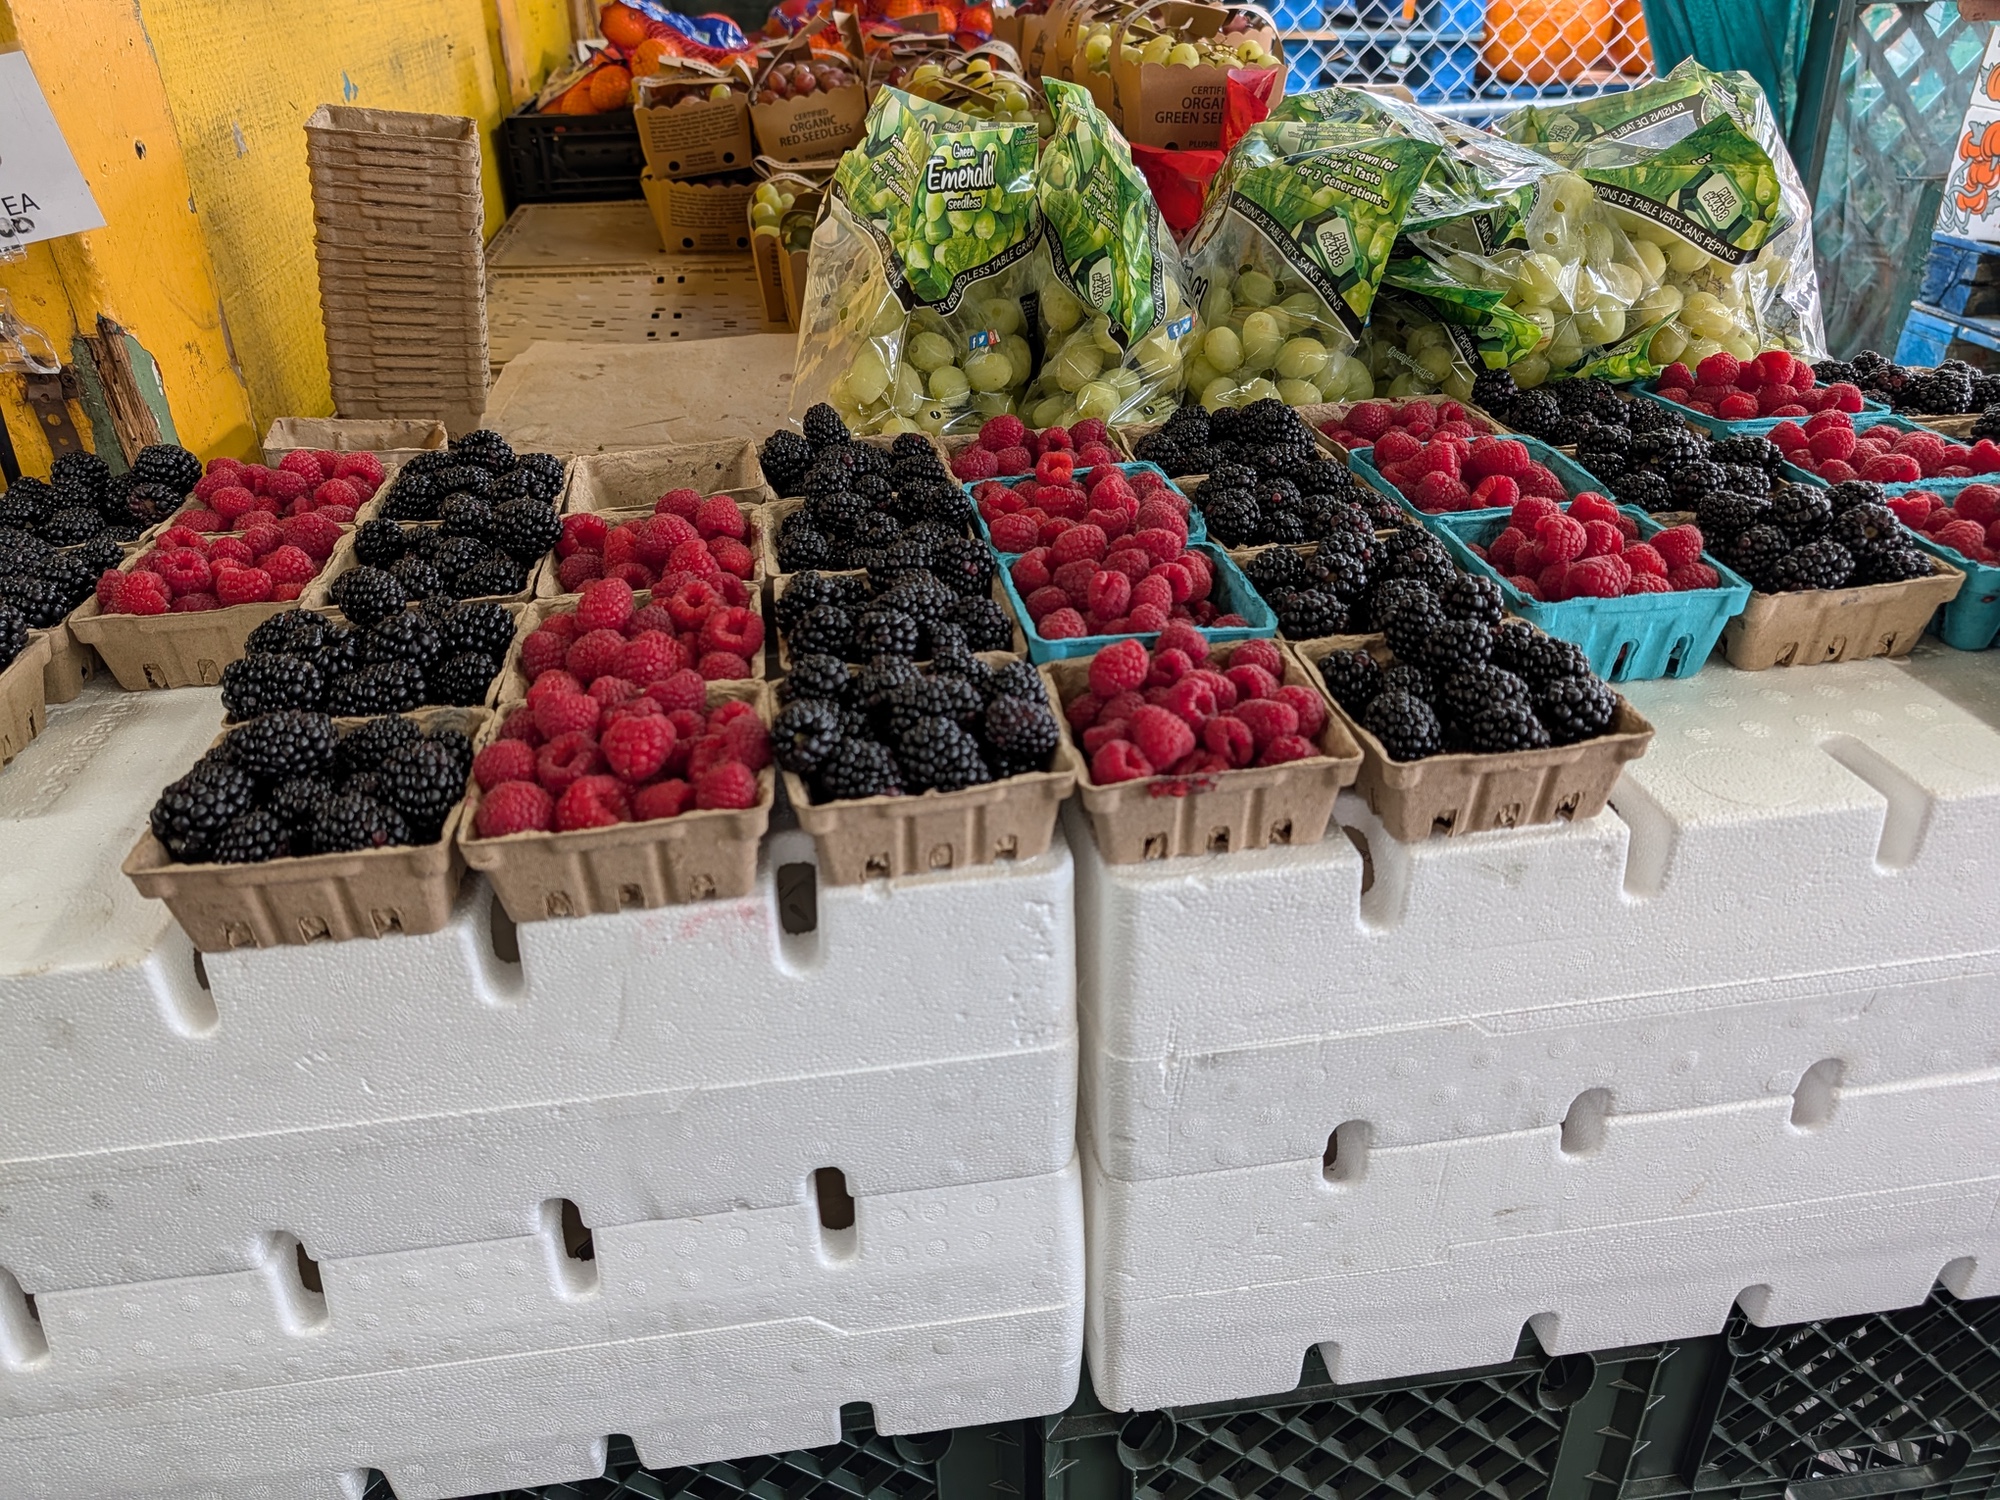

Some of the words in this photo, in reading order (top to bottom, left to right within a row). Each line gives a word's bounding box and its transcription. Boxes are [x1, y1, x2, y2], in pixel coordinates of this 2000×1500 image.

[1192, 85, 1226, 95] CERTIFI
[790, 115, 837, 134] ORGANIC
[794, 108, 828, 121] CERTIFIED
[1155, 111, 1199, 124] GREEN
[779, 134, 800, 147] RED
[802, 123, 852, 143] SEEDLESS
[884, 151, 905, 174] Flavor
[952, 141, 976, 160] Green
[1348, 149, 1380, 166] Grown
[1380, 156, 1399, 173] for
[871, 161, 883, 175] for
[880, 170, 889, 180] 3
[926, 151, 996, 193] Emerald
[1297, 163, 1314, 178] for
[1312, 168, 1322, 181] 3
[1313, 154, 1344, 171] Flavor
[1342, 162, 1353, 175] &
[1354, 166, 1381, 187] Taste
[1, 192, 41, 216] EA
[947, 194, 982, 211] seedless
[1703, 190, 1731, 222] #4498
[1717, 186, 1737, 208] PLU
[1593, 184, 1619, 201] AISINS
[1619, 192, 1633, 206] DE
[1633, 196, 1659, 217] TABLE
[1659, 208, 1684, 230] VERTS
[1681, 220, 1707, 243] SANS
[1702, 236, 1738, 262] PÉPINS
[1234, 197, 1261, 219] RAISINS
[1256, 213, 1269, 228] DE
[1266, 220, 1286, 243] TABLE
[1280, 237, 1300, 261] VERTS
[1297, 256, 1322, 282] SANS
[1317, 278, 1344, 312] PÉPINS
[1320, 230, 1344, 267] #4498
[1333, 231, 1350, 256] PLU
[931, 288, 960, 313] GREEN
[991, 248, 1015, 272] TABLE
[1091, 271, 1103, 308] #4498
[1102, 273, 1112, 299] PLU
